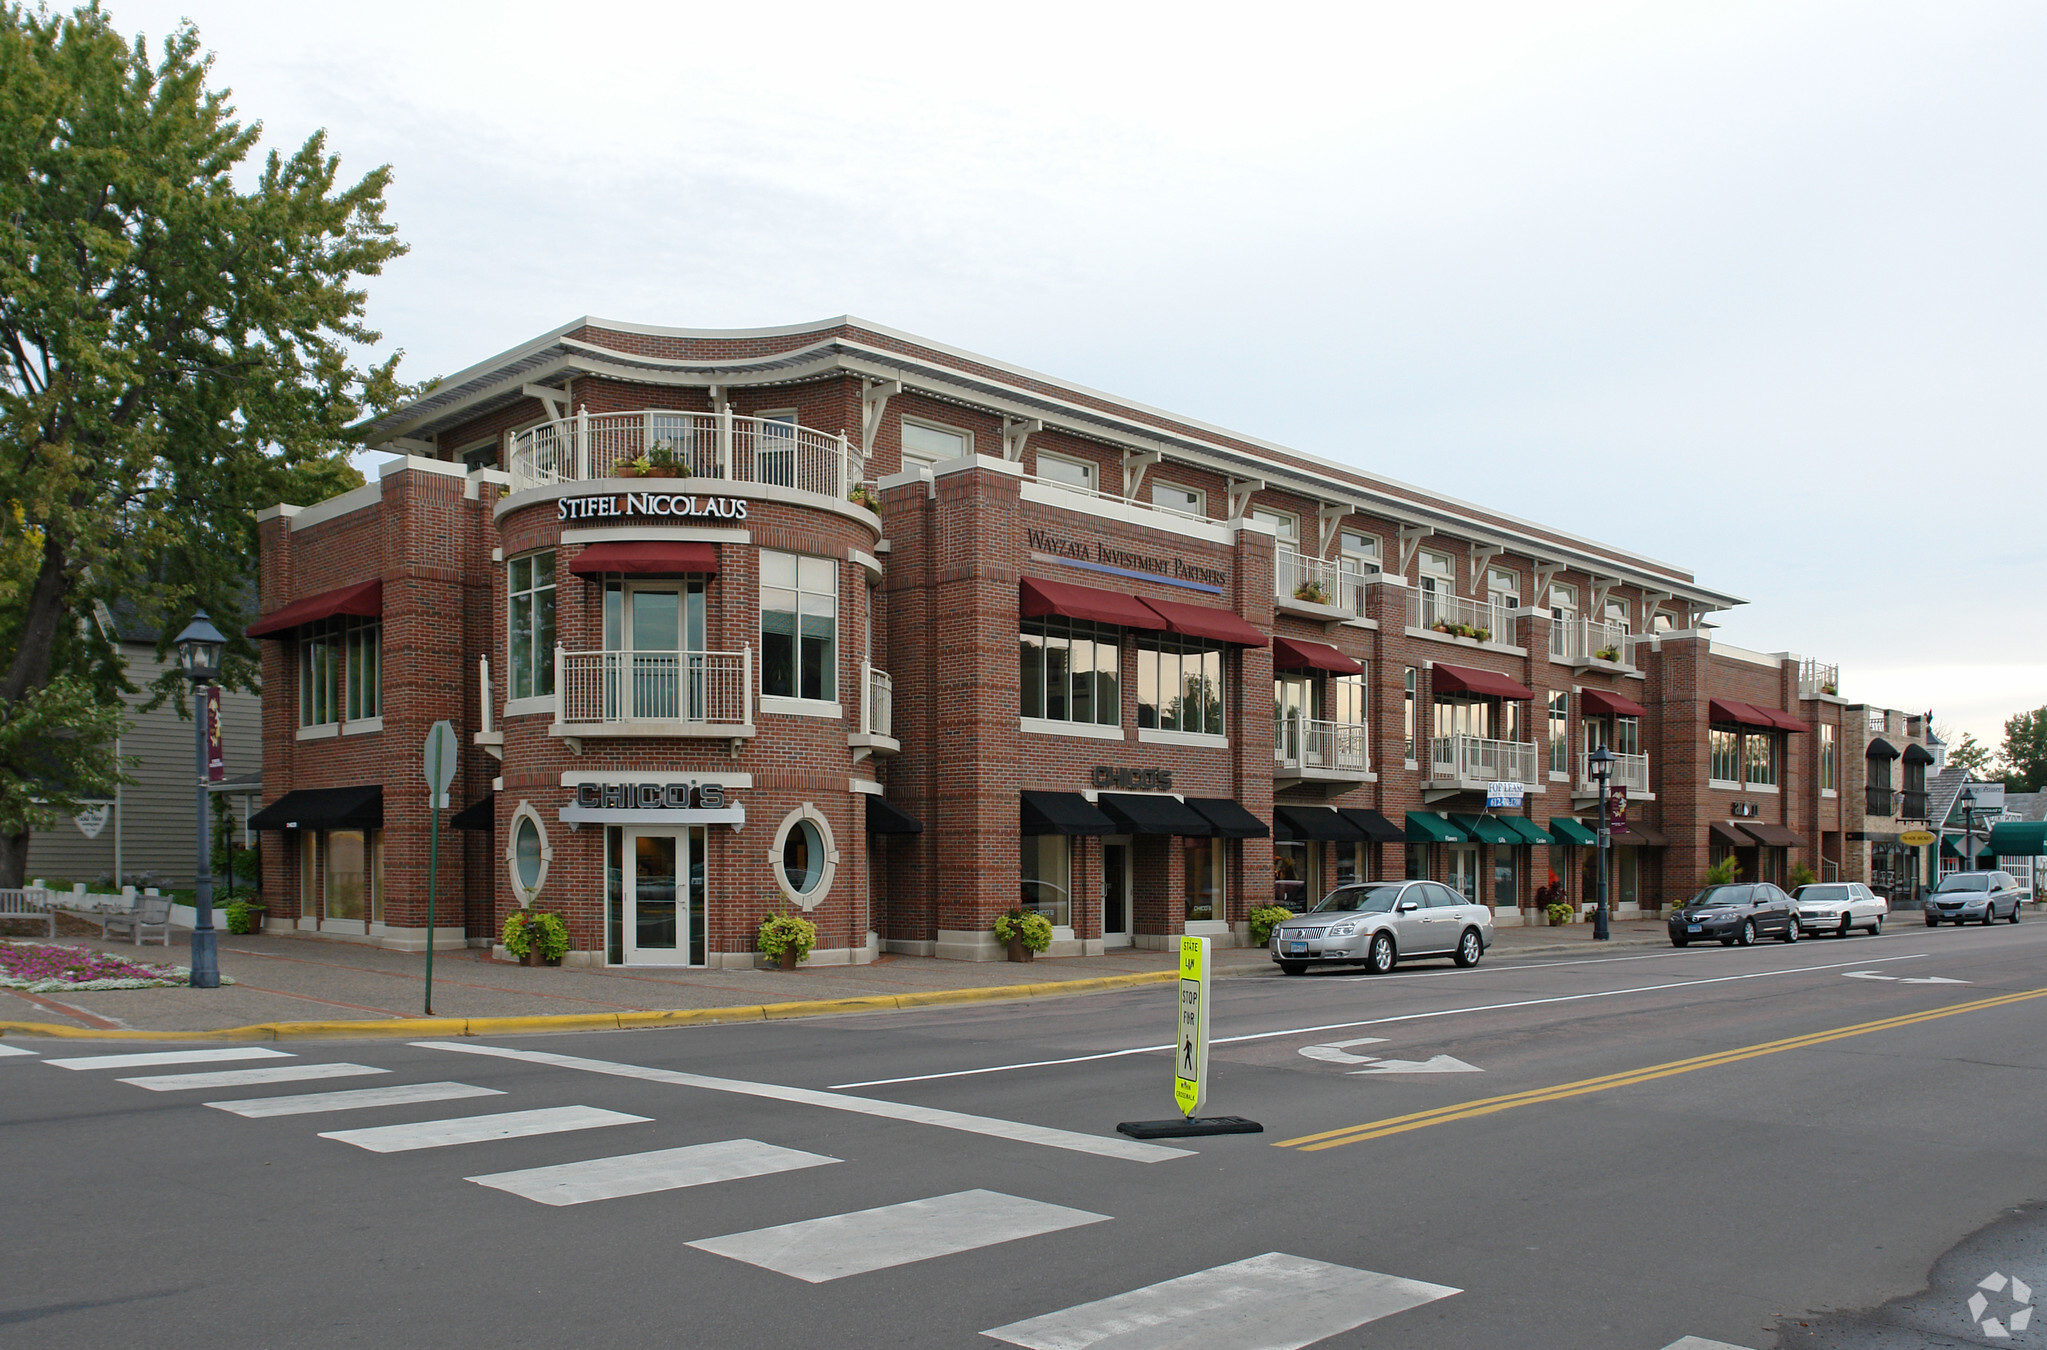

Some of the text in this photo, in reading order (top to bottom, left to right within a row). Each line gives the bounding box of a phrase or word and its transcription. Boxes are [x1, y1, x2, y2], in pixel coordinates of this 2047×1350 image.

[557, 492, 748, 520] STIFEL NICOLAUS
[1027, 528, 1226, 585] WAYZATA INVESTMENT PARTNERS
[1093, 766, 1173, 789] CHICO'S
[577, 779, 724, 808] CHICO'S
[1184, 941, 1198, 952] STATE
[1185, 957, 1195, 968] LAW
[1182, 990, 1197, 1005] STOP
[1183, 1010, 1195, 1026] FOR
